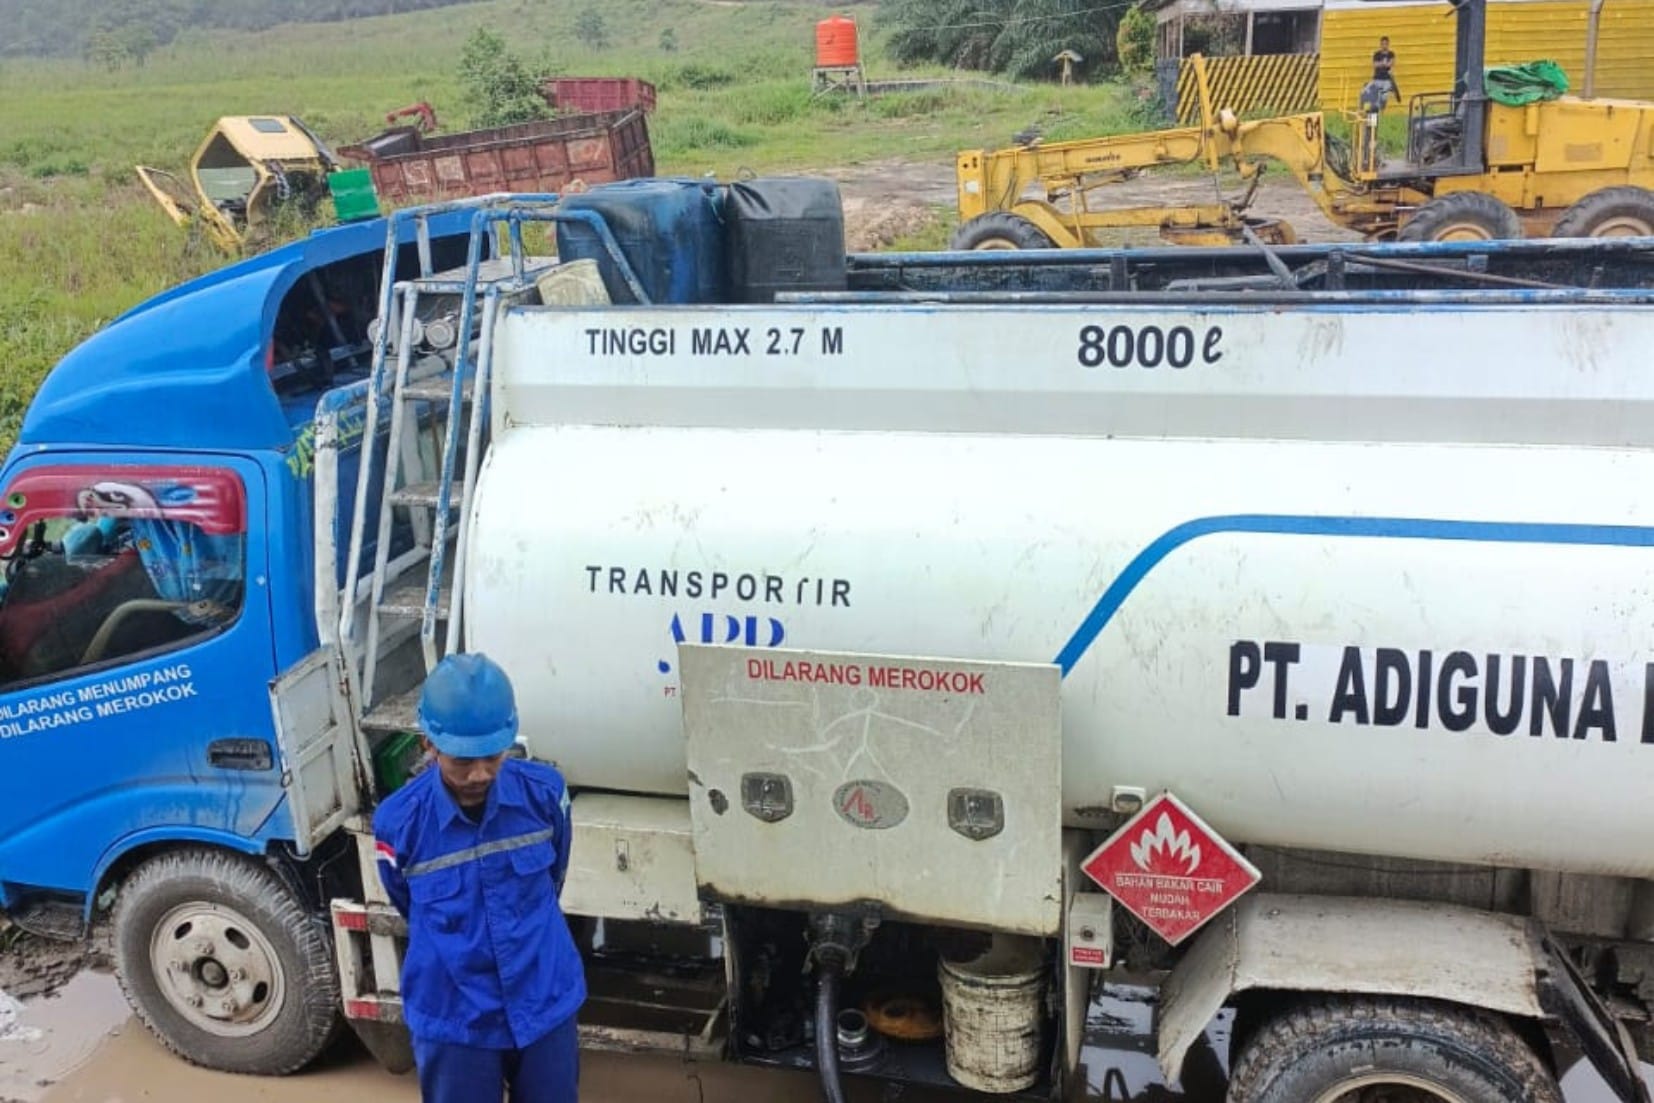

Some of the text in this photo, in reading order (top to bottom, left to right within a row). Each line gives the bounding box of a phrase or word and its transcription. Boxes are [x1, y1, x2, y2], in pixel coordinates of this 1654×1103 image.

[586, 327, 843, 355] TINGGI MAX 2.7 M
[78, 664, 192, 703] MENUMPANG
[747, 658, 985, 694] DILARANG MEROKOK
[1227, 640, 1308, 721] PT.
[1328, 645, 1618, 743] ADIGUNA
[0, 682, 198, 739] DILARANG MEROKOK
